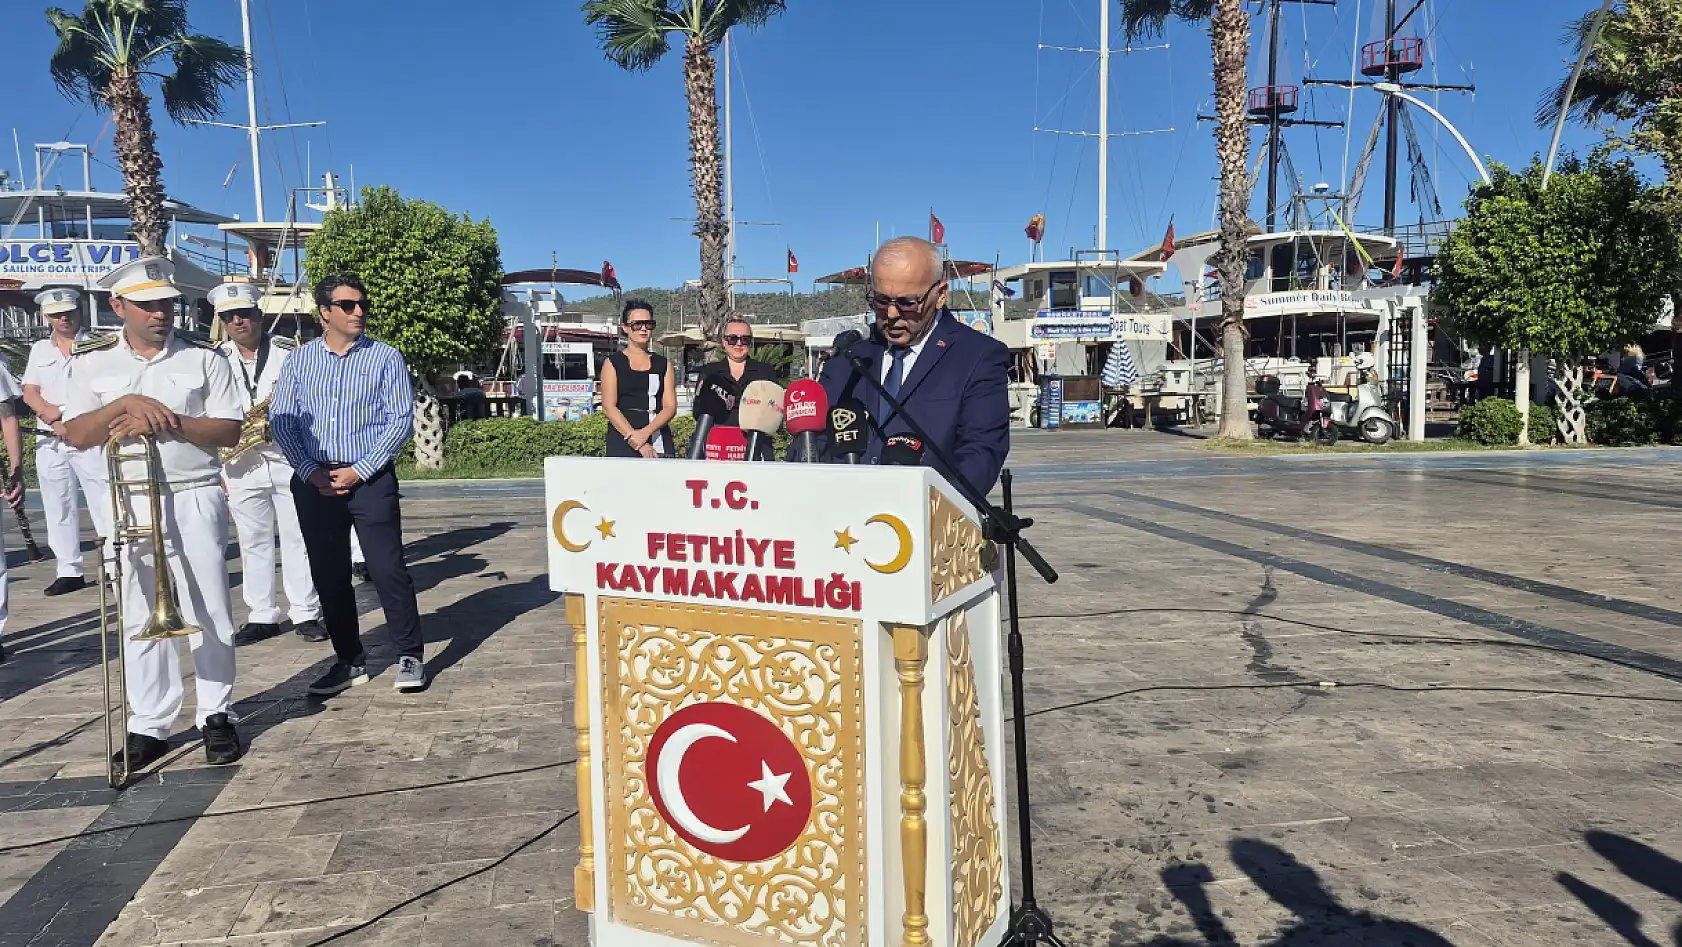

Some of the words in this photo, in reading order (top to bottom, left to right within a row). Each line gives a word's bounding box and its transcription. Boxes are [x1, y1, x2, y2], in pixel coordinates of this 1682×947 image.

[3, 264, 45, 273] SAILING
[47, 264, 78, 273] BOAT
[81, 264, 112, 273] TRIPS
[1260, 294, 1308, 306] Summer
[1311, 291, 1336, 302] Daily
[1129, 318, 1150, 335] Tours
[835, 430, 859, 442] FET
[685, 479, 759, 510] T.C.
[647, 529, 796, 570] FETHİYE
[596, 562, 862, 611] KAYMAKAMLIĞI
